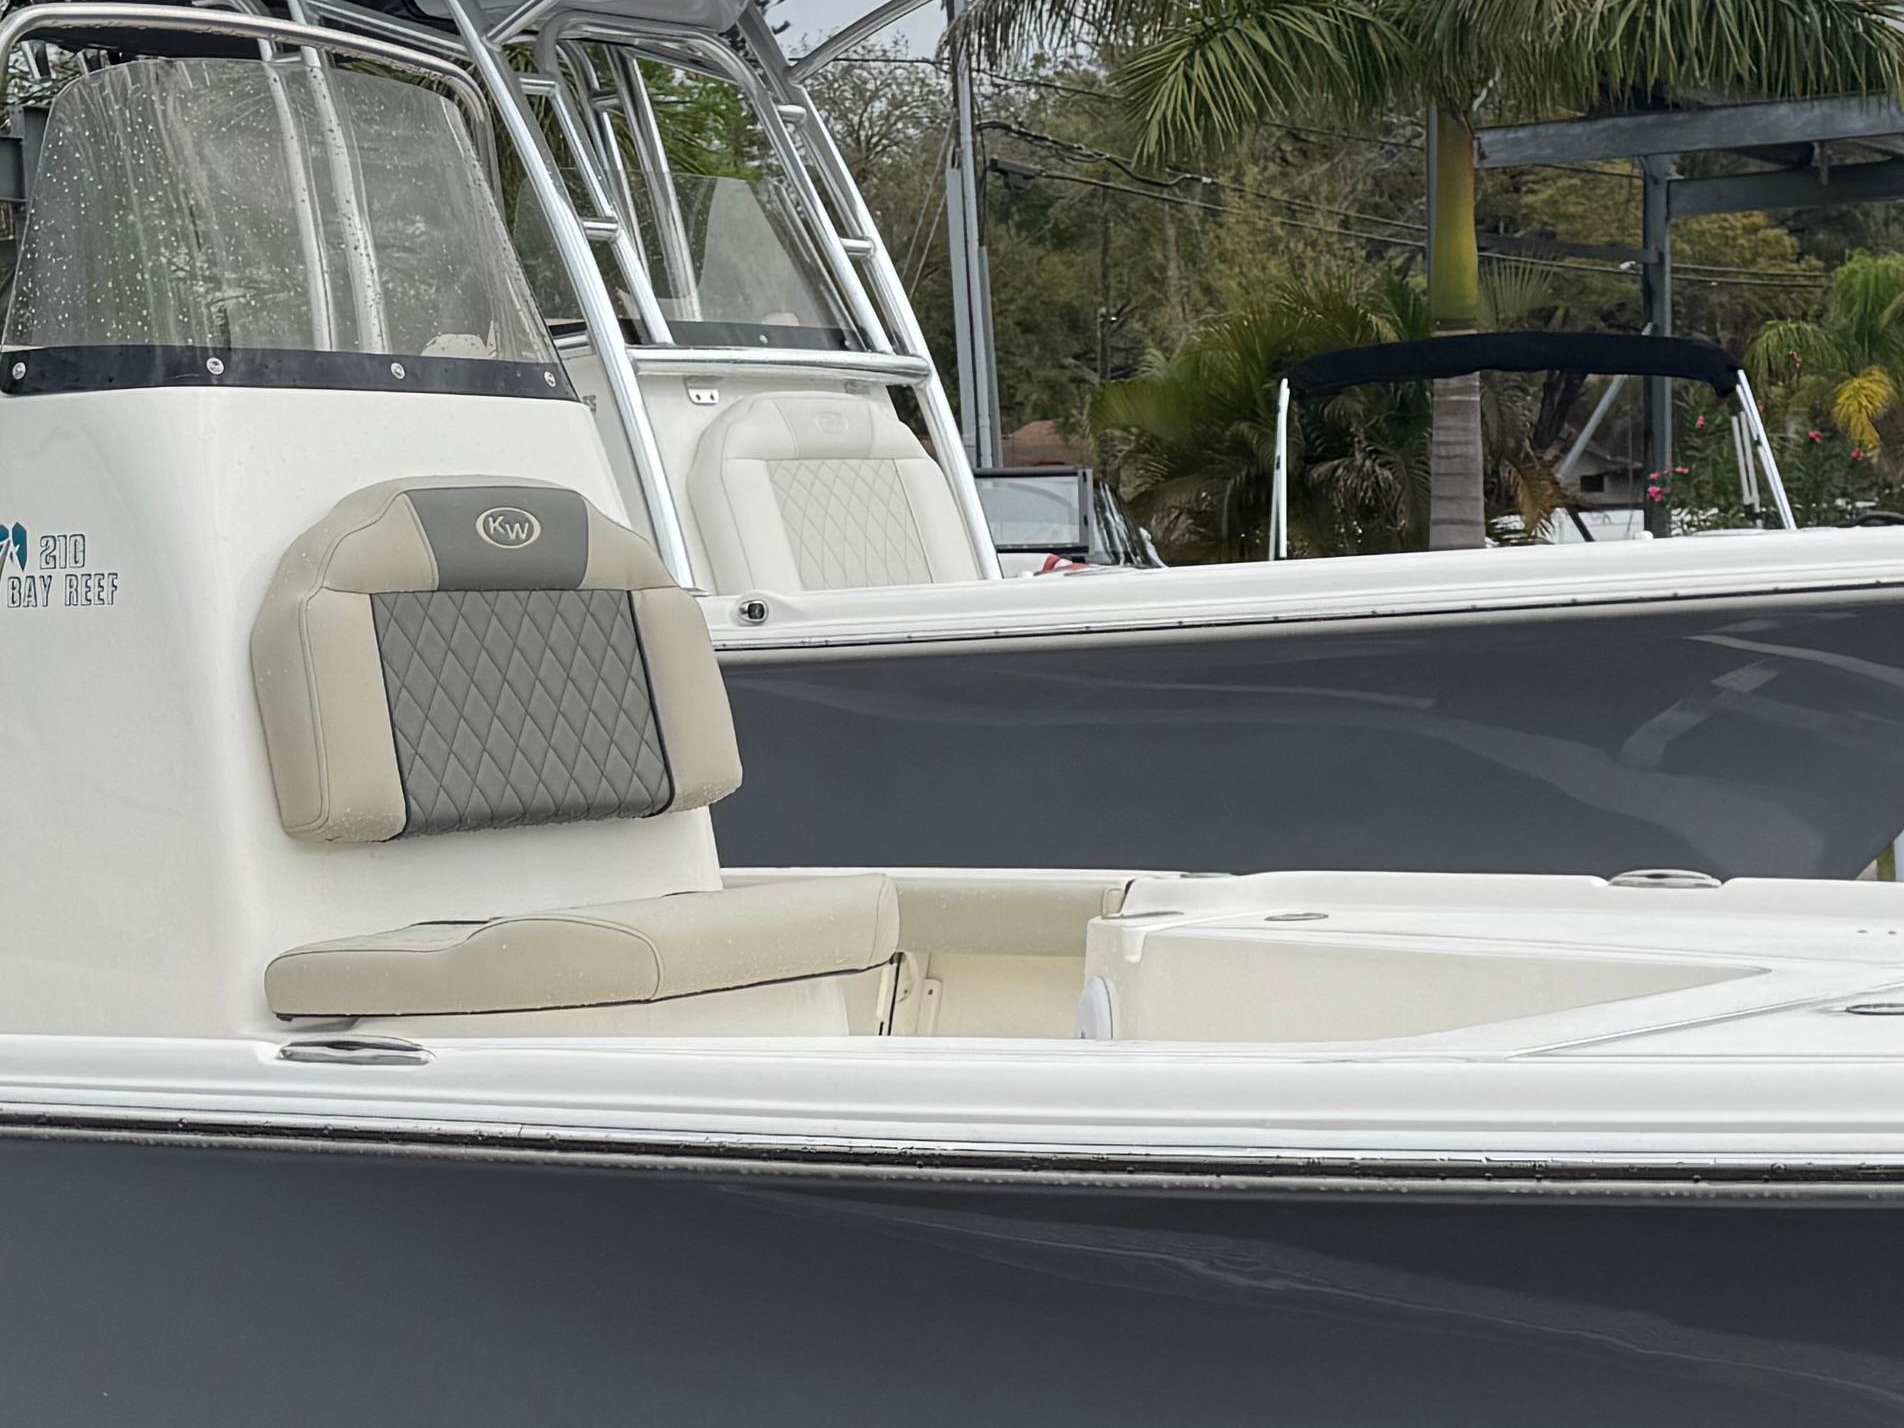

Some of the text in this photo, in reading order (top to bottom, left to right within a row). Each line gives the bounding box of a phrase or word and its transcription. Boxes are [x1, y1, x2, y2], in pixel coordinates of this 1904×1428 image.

[39, 533, 86, 570] 210
[7, 572, 119, 608] BAY REEF
